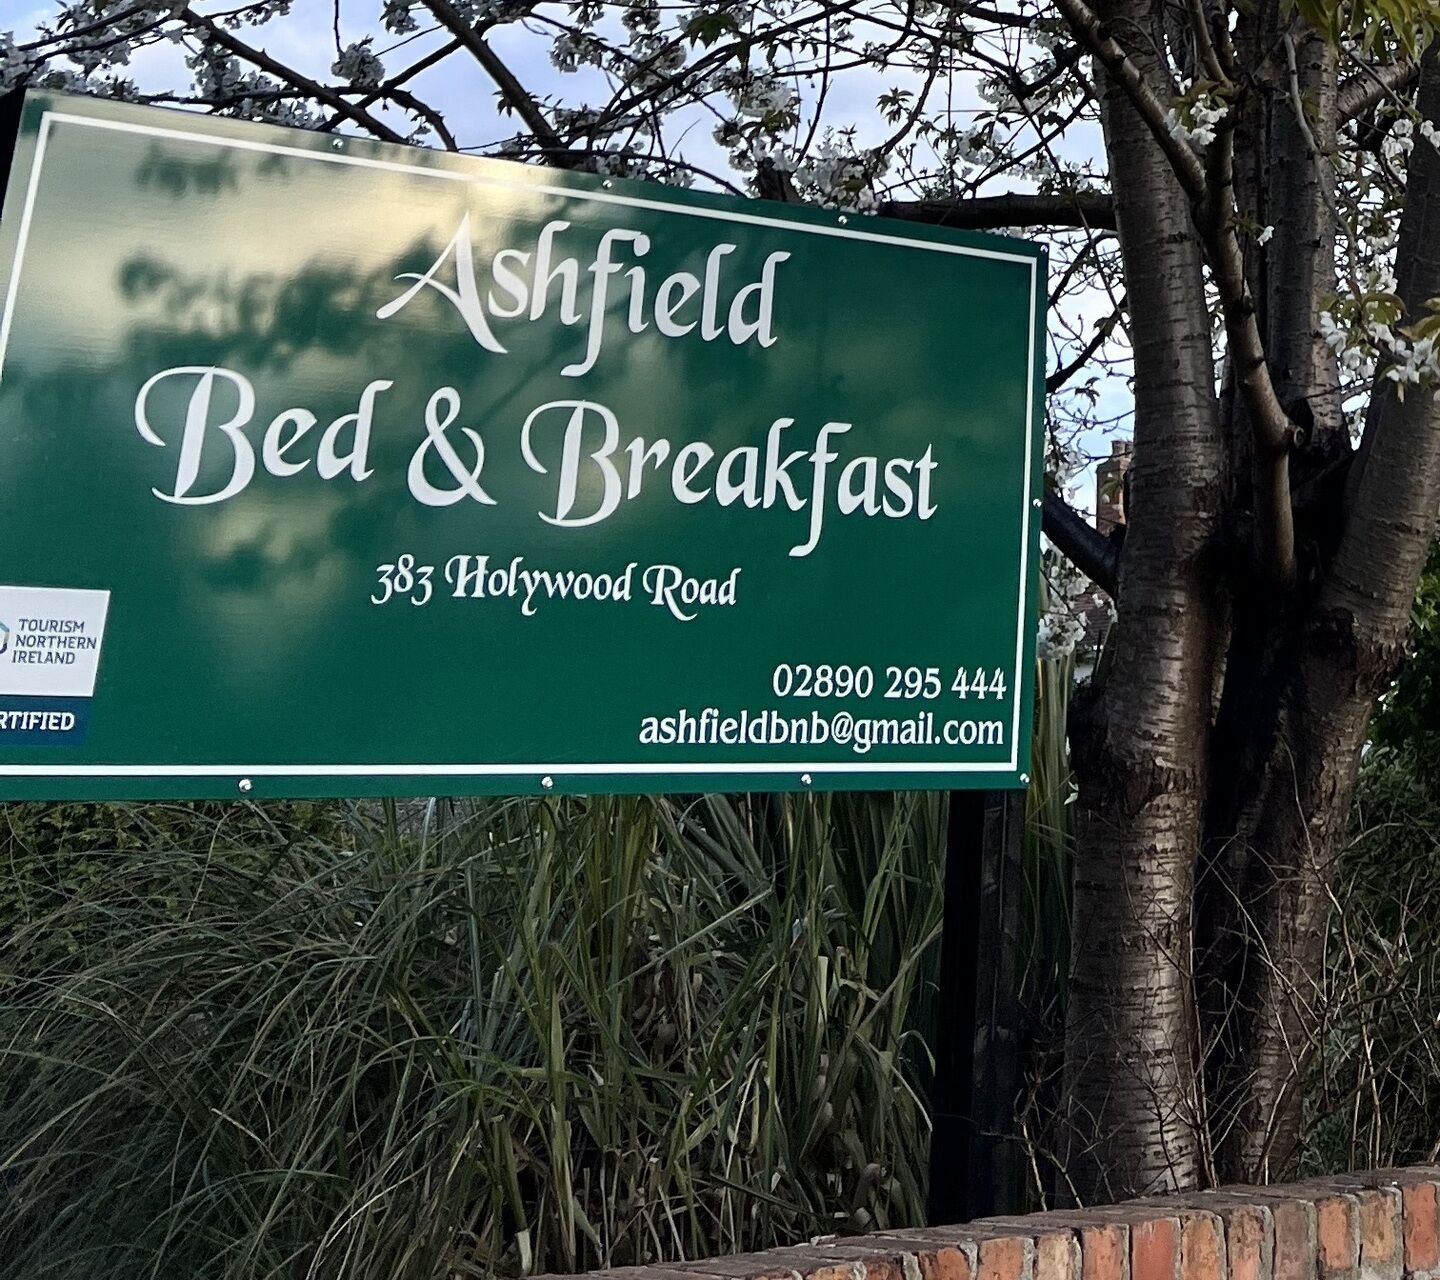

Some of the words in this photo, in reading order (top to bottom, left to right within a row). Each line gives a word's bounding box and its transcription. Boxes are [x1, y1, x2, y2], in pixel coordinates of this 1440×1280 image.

[376, 210, 791, 377] Ashfield
[134, 365, 394, 505] Bed
[407, 386, 497, 507] &
[520, 400, 939, 557] Breakfast
[371, 553, 435, 606] 383
[444, 554, 638, 616] Holywood
[642, 564, 742, 621] Road
[15, 634, 98, 650] NORTHERN
[18, 618, 86, 634] TOURISM
[11, 649, 76, 665] IRELAND
[772, 663, 874, 698] 02890
[883, 666, 942, 700] 295
[950, 666, 1007, 700] 444
[639, 708, 1004, 754] ashfieldbnb@gmail.com
